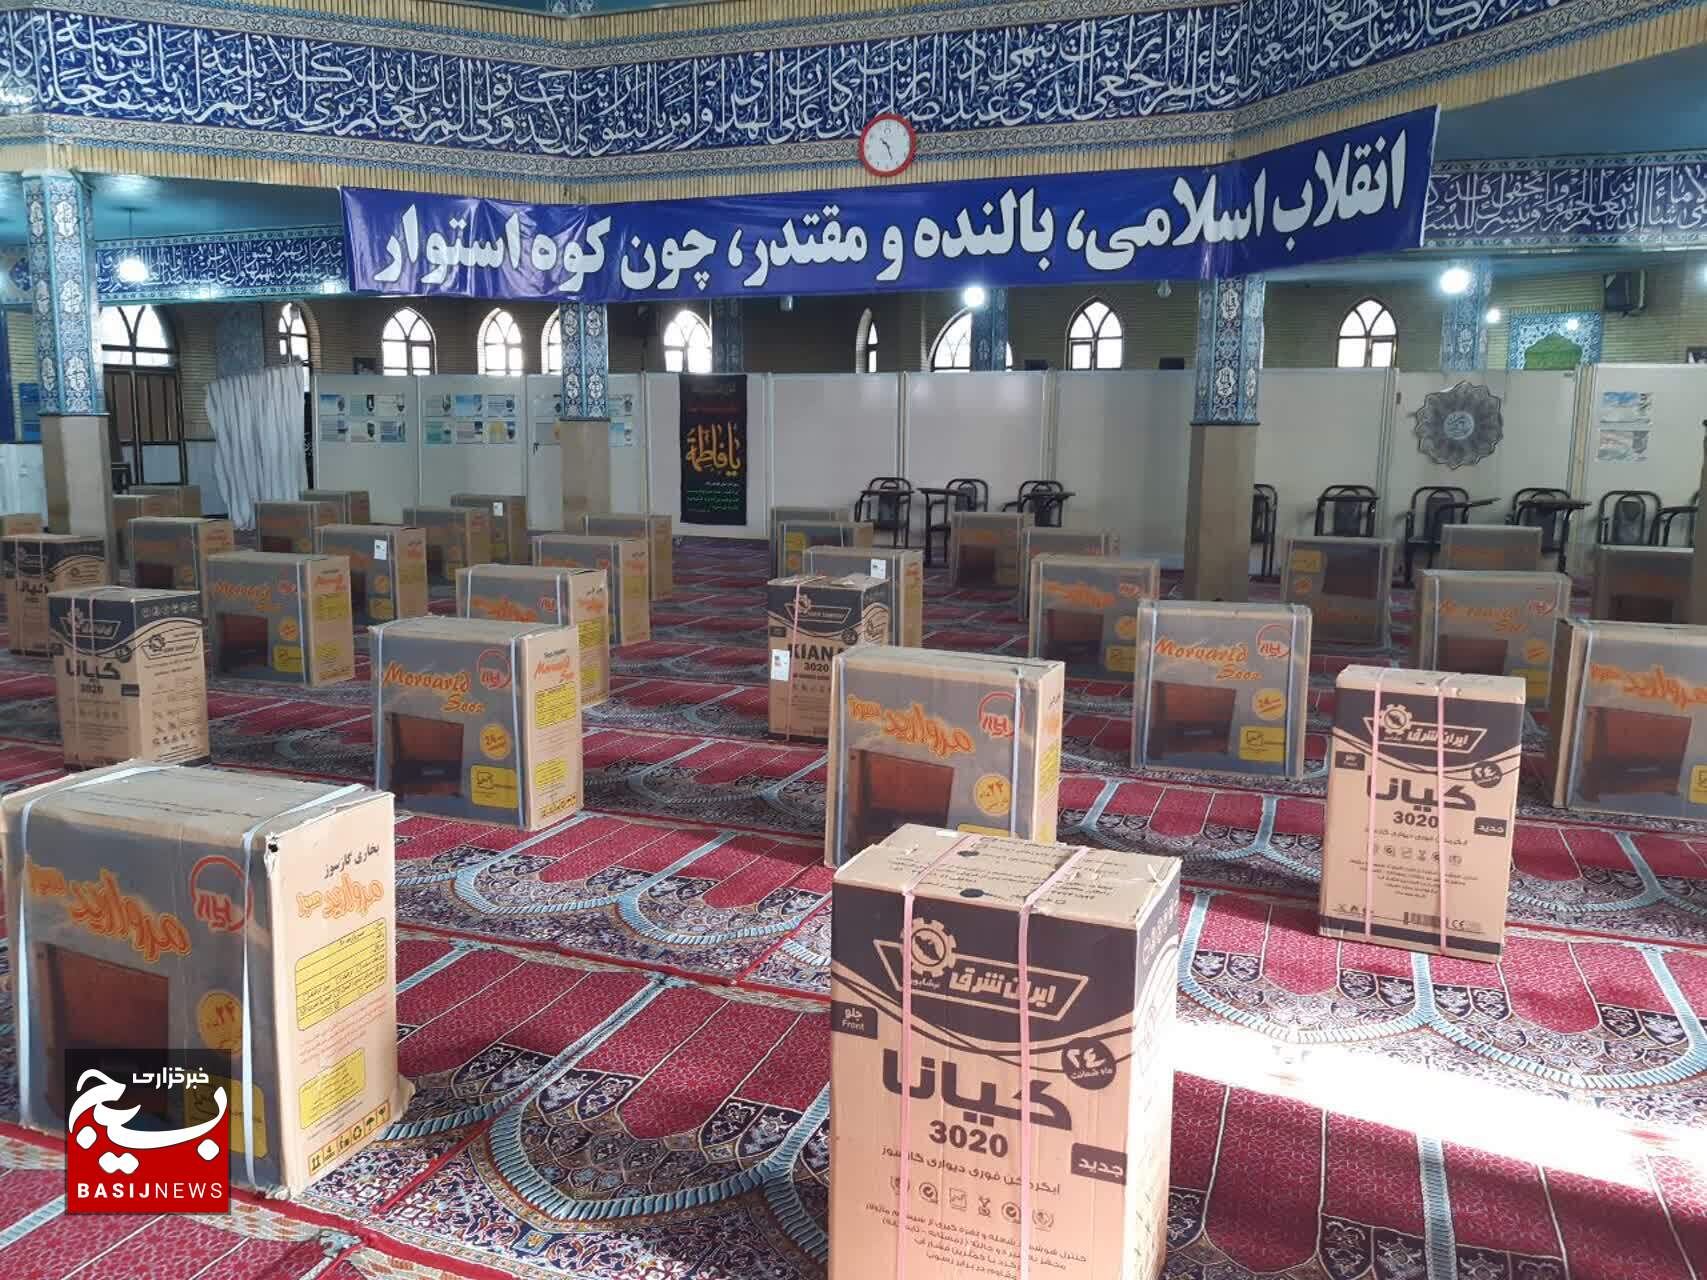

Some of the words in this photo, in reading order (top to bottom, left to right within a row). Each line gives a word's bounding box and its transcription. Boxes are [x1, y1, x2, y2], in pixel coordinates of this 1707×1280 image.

[1273, 129, 1407, 254] انقلاب
[373, 203, 521, 285] استوار
[531, 216, 611, 293] کوه
[620, 223, 717, 290] چون
[876, 226, 903, 283] و
[913, 187, 1055, 272] بالنده
[1393, 810, 1440, 829] 3020
[842, 1020, 865, 1032] Front
[882, 1048, 1073, 1132] کیانا
[929, 1119, 1009, 1158] 3020
[1078, 1157, 1124, 1178] جدید
